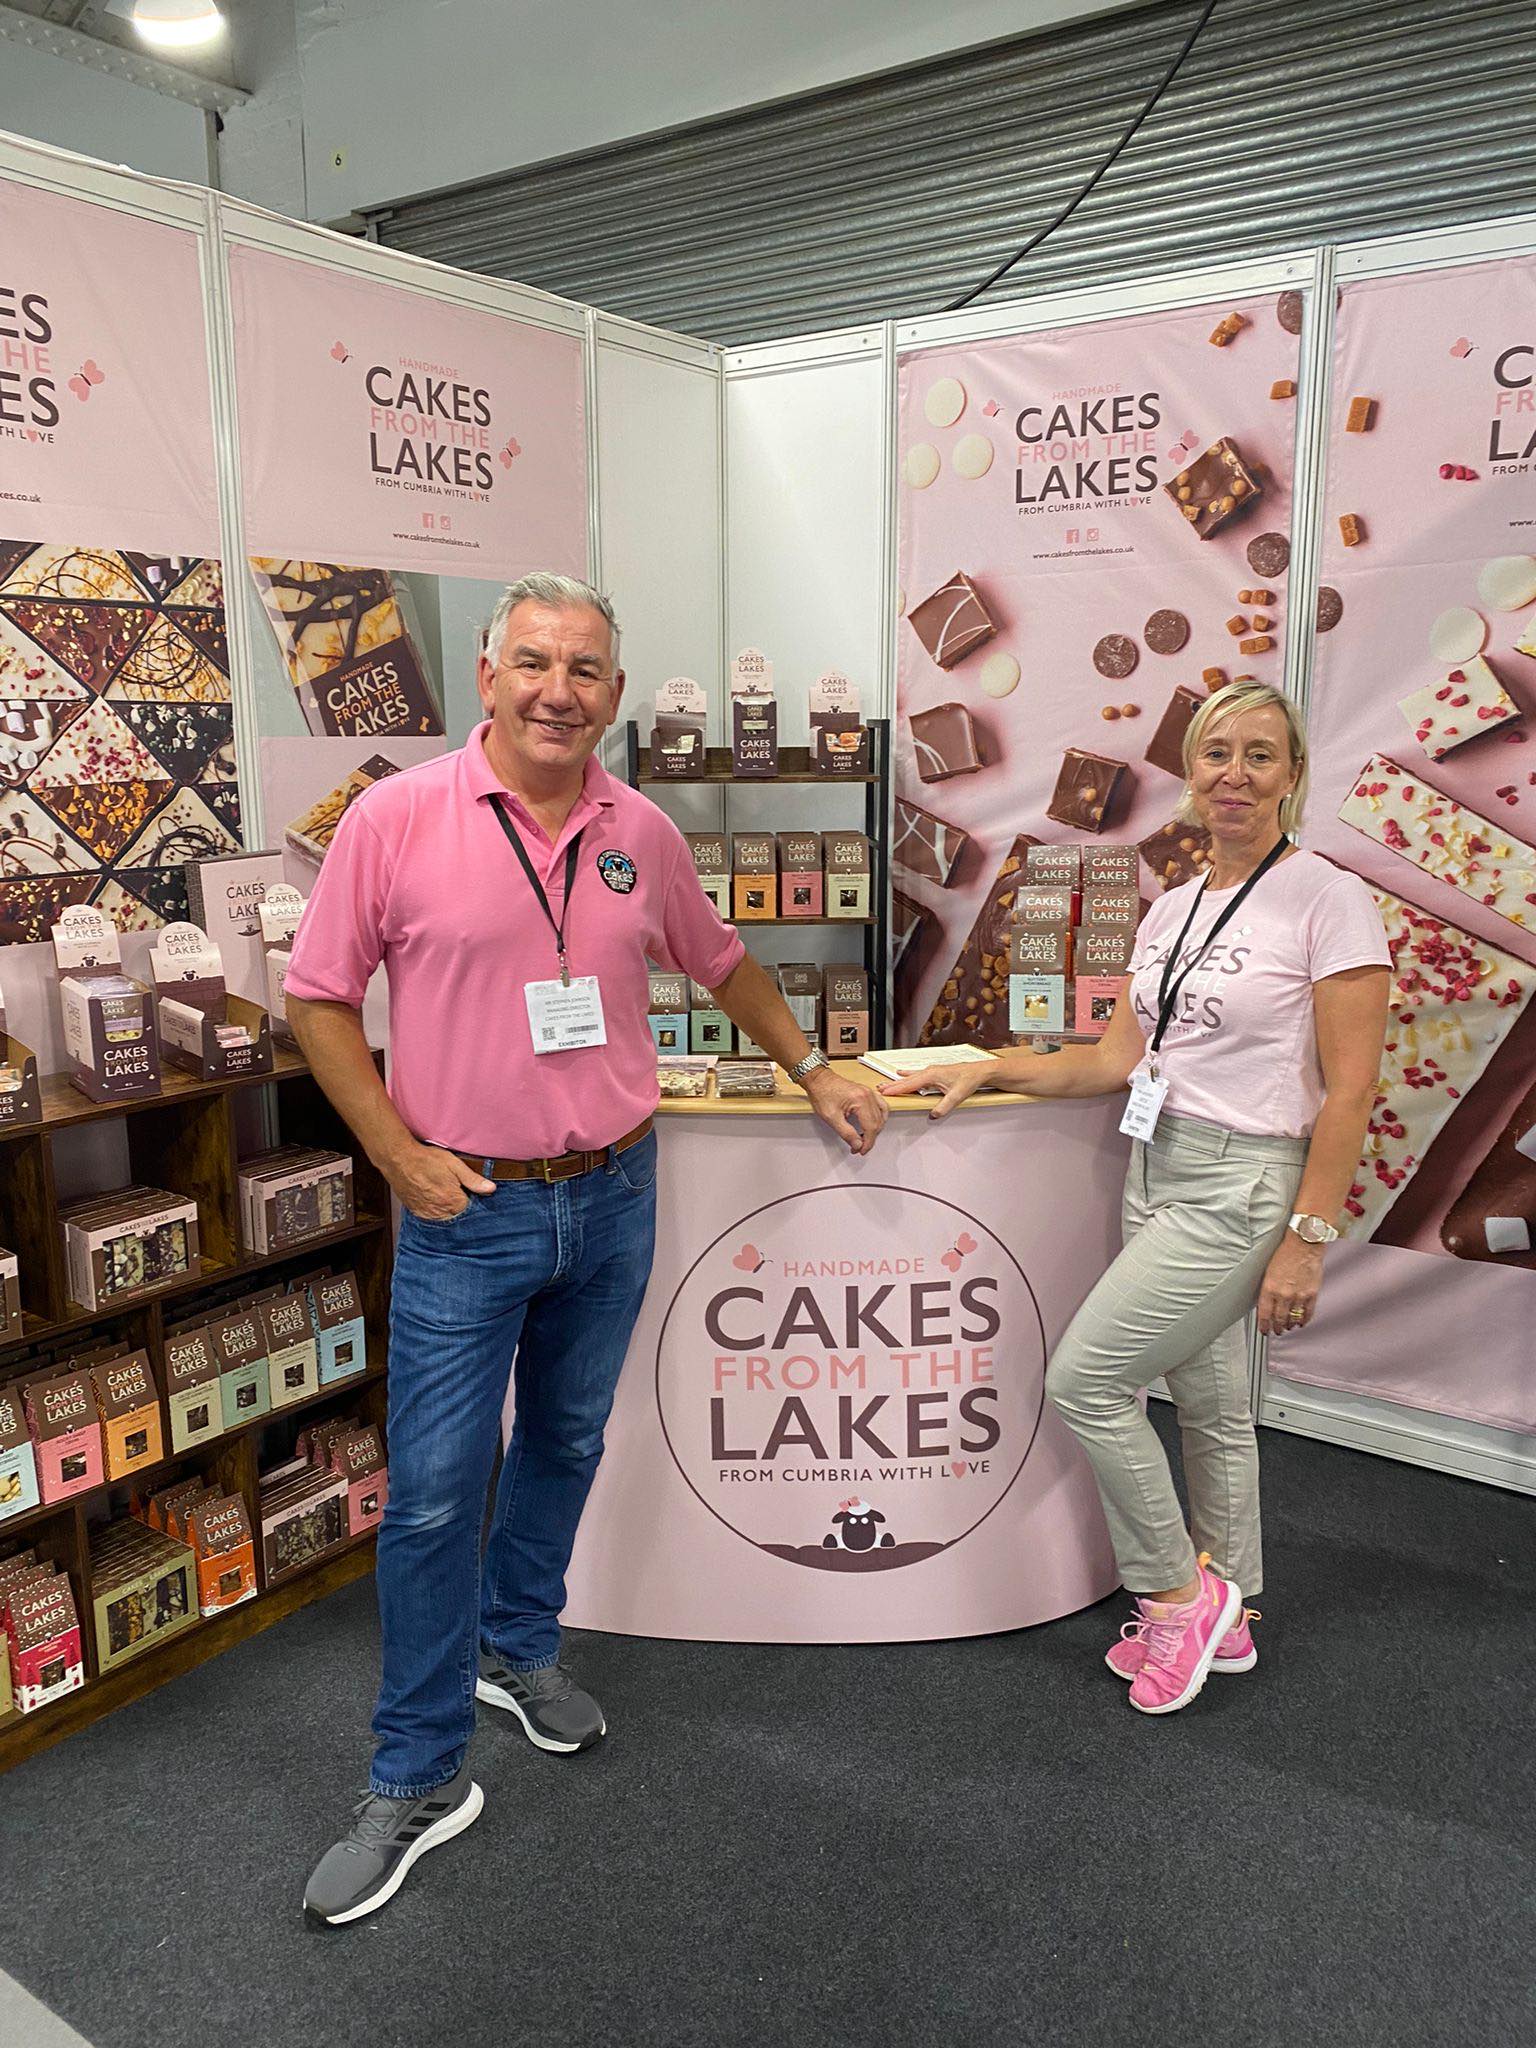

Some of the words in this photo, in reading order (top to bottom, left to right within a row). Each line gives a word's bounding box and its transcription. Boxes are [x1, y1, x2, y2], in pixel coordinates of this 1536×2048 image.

[399, 356, 459, 379] HANDMADE
[365, 365, 491, 427] CAKES
[1052, 383, 1121, 400] HANDMADE
[1015, 392, 1160, 443] CAKES
[370, 406, 437, 440] FROM
[446, 421, 489, 449] THE
[1018, 438, 1090, 465] FROM
[1102, 431, 1156, 456] THE
[370, 432, 493, 490] LAKES
[1492, 463, 1528, 475] FROM
[375, 477, 400, 489] FROM
[403, 481, 442, 495] CUMBRIA
[445, 488, 466, 499] WITH
[1015, 455, 1158, 504] LAKES
[1018, 506, 1044, 515] FROM
[1047, 502, 1092, 513] CUMBRIA
[1095, 499, 1121, 509] WITH
[392, 531, 480, 548] www.cakesfromthelakes.co.uk
[1033, 546, 1134, 560] www.cakesfromthelakes.co.uk
[738, 665, 765, 673] LAKES
[327, 661, 398, 711] CAKES
[334, 697, 373, 724] FROM
[374, 682, 401, 702] THE
[740, 739, 771, 748] CAKES
[740, 750, 771, 759] LAKES
[788, 843, 815, 851] CAKES
[834, 845, 862, 853] CAKES
[695, 856, 722, 864] LAKES
[741, 856, 769, 864] LAKES
[788, 853, 815, 861] LAKES
[835, 855, 863, 863] LAKES
[1035, 856, 1071, 866] CAKES
[1091, 857, 1129, 867] CAKES
[1035, 869, 1071, 879] LAKES
[1091, 870, 1129, 880] LAKES
[226, 882, 265, 899] CAKES
[267, 894, 300, 904] CAKES
[228, 901, 265, 919] LAKE
[1026, 897, 1063, 906] CAKES
[1092, 898, 1130, 908] CAKES
[63, 915, 101, 927] CAKES
[1025, 910, 1062, 919] LAKES
[1091, 911, 1129, 921] LAKES
[66, 928, 104, 940] LAKES
[165, 933, 200, 944] CAKES
[1020, 937, 1057, 946] CAKES
[1087, 938, 1125, 947] CAKES
[167, 944, 202, 956] LAKES
[1020, 951, 1057, 960] LAKES
[1086, 951, 1125, 961] LAKES
[653, 986, 680, 994] CAKES
[835, 983, 862, 991] CAKES
[653, 996, 680, 1004] LAKES
[835, 992, 862, 1001] LAKES
[558, 1039, 587, 1047] EXHIBITOR
[103, 1046, 148, 1061] CAKES
[226, 1049, 252, 1058] CAKES
[226, 1057, 251, 1067] LAKES
[105, 1061, 149, 1078] LAKES
[784, 1257, 925, 1278] HANDMADE
[321, 1283, 352, 1302] CAKES
[270, 1304, 302, 1323] CAKES
[324, 1297, 354, 1314] LAKES
[704, 1277, 1001, 1351] CAKES
[222, 1323, 255, 1342] CAKES
[273, 1318, 304, 1337] LAKES
[170, 1342, 205, 1362] CAKES
[225, 1336, 258, 1357] LAKES
[173, 1356, 208, 1377] LAKES
[714, 1353, 867, 1391] FROM
[889, 1346, 994, 1389] THE
[107, 1365, 143, 1386] CAKES
[44, 1385, 84, 1406] CAKES
[111, 1380, 147, 1401] LAKES
[46, 1400, 87, 1422] LAKES
[710, 1387, 1001, 1461] LAKES
[347, 1437, 376, 1456] CAKES
[350, 1449, 378, 1469] LAKES
[719, 1468, 774, 1483] FROM
[782, 1467, 873, 1482] CUMBRIA
[879, 1465, 933, 1480] WITH
[203, 1507, 240, 1528] CAKES
[206, 1521, 243, 1543] LAKES
[21, 1590, 63, 1617] CAKES
[25, 1605, 66, 1632] LAKES
